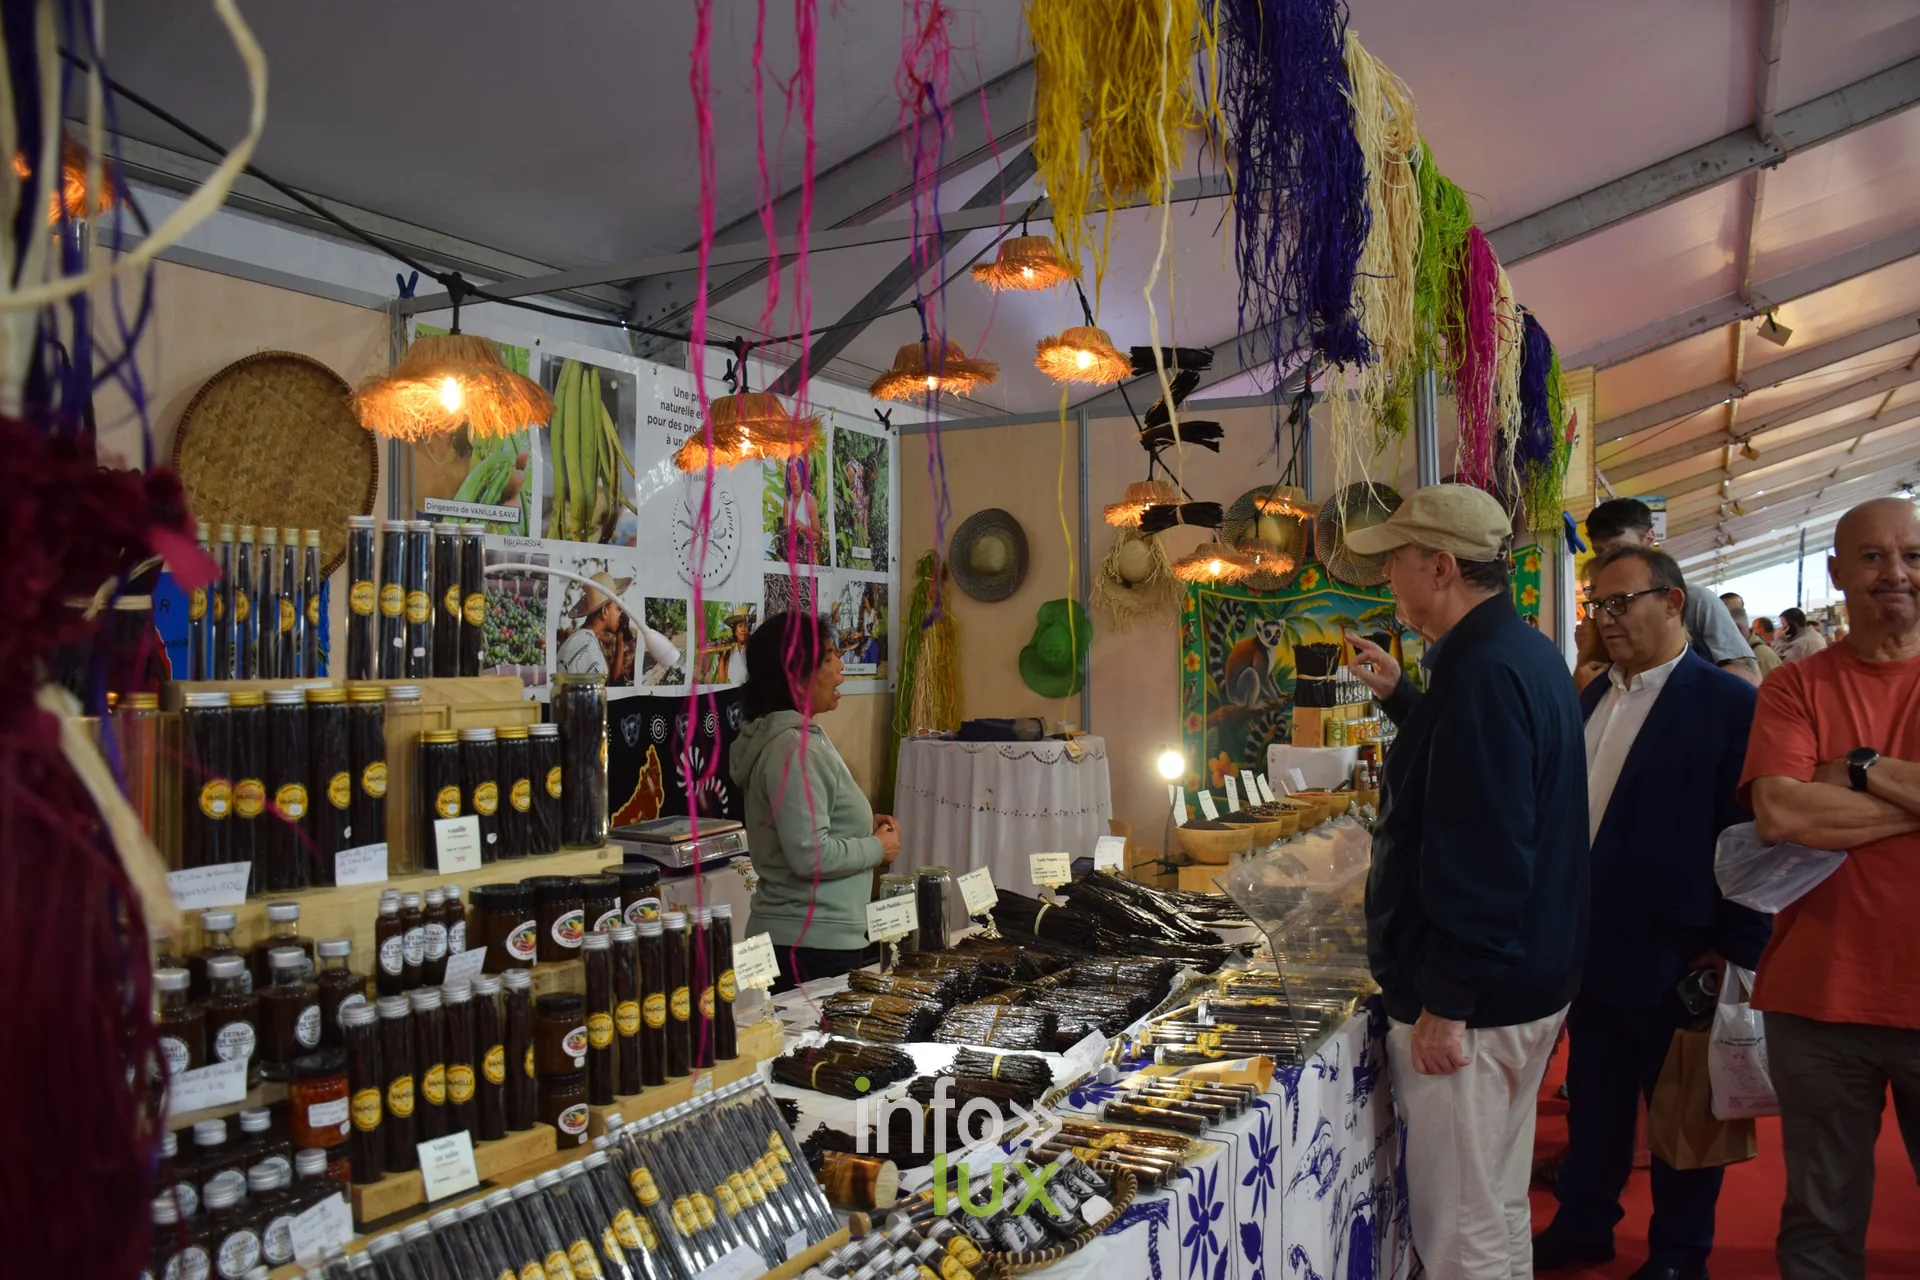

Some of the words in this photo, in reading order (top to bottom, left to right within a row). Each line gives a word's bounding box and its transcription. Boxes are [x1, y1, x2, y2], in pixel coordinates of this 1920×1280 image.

[674, 386, 690, 400] Une
[660, 400, 695, 418] naturelle
[647, 414, 667, 429] pour
[668, 418, 682, 431] des
[666, 432, 672, 445] à
[426, 502, 459, 514] Dirigeante
[460, 505, 469, 514] de
[470, 508, 498, 518] VANILLA
[499, 510, 518, 519] SAVA
